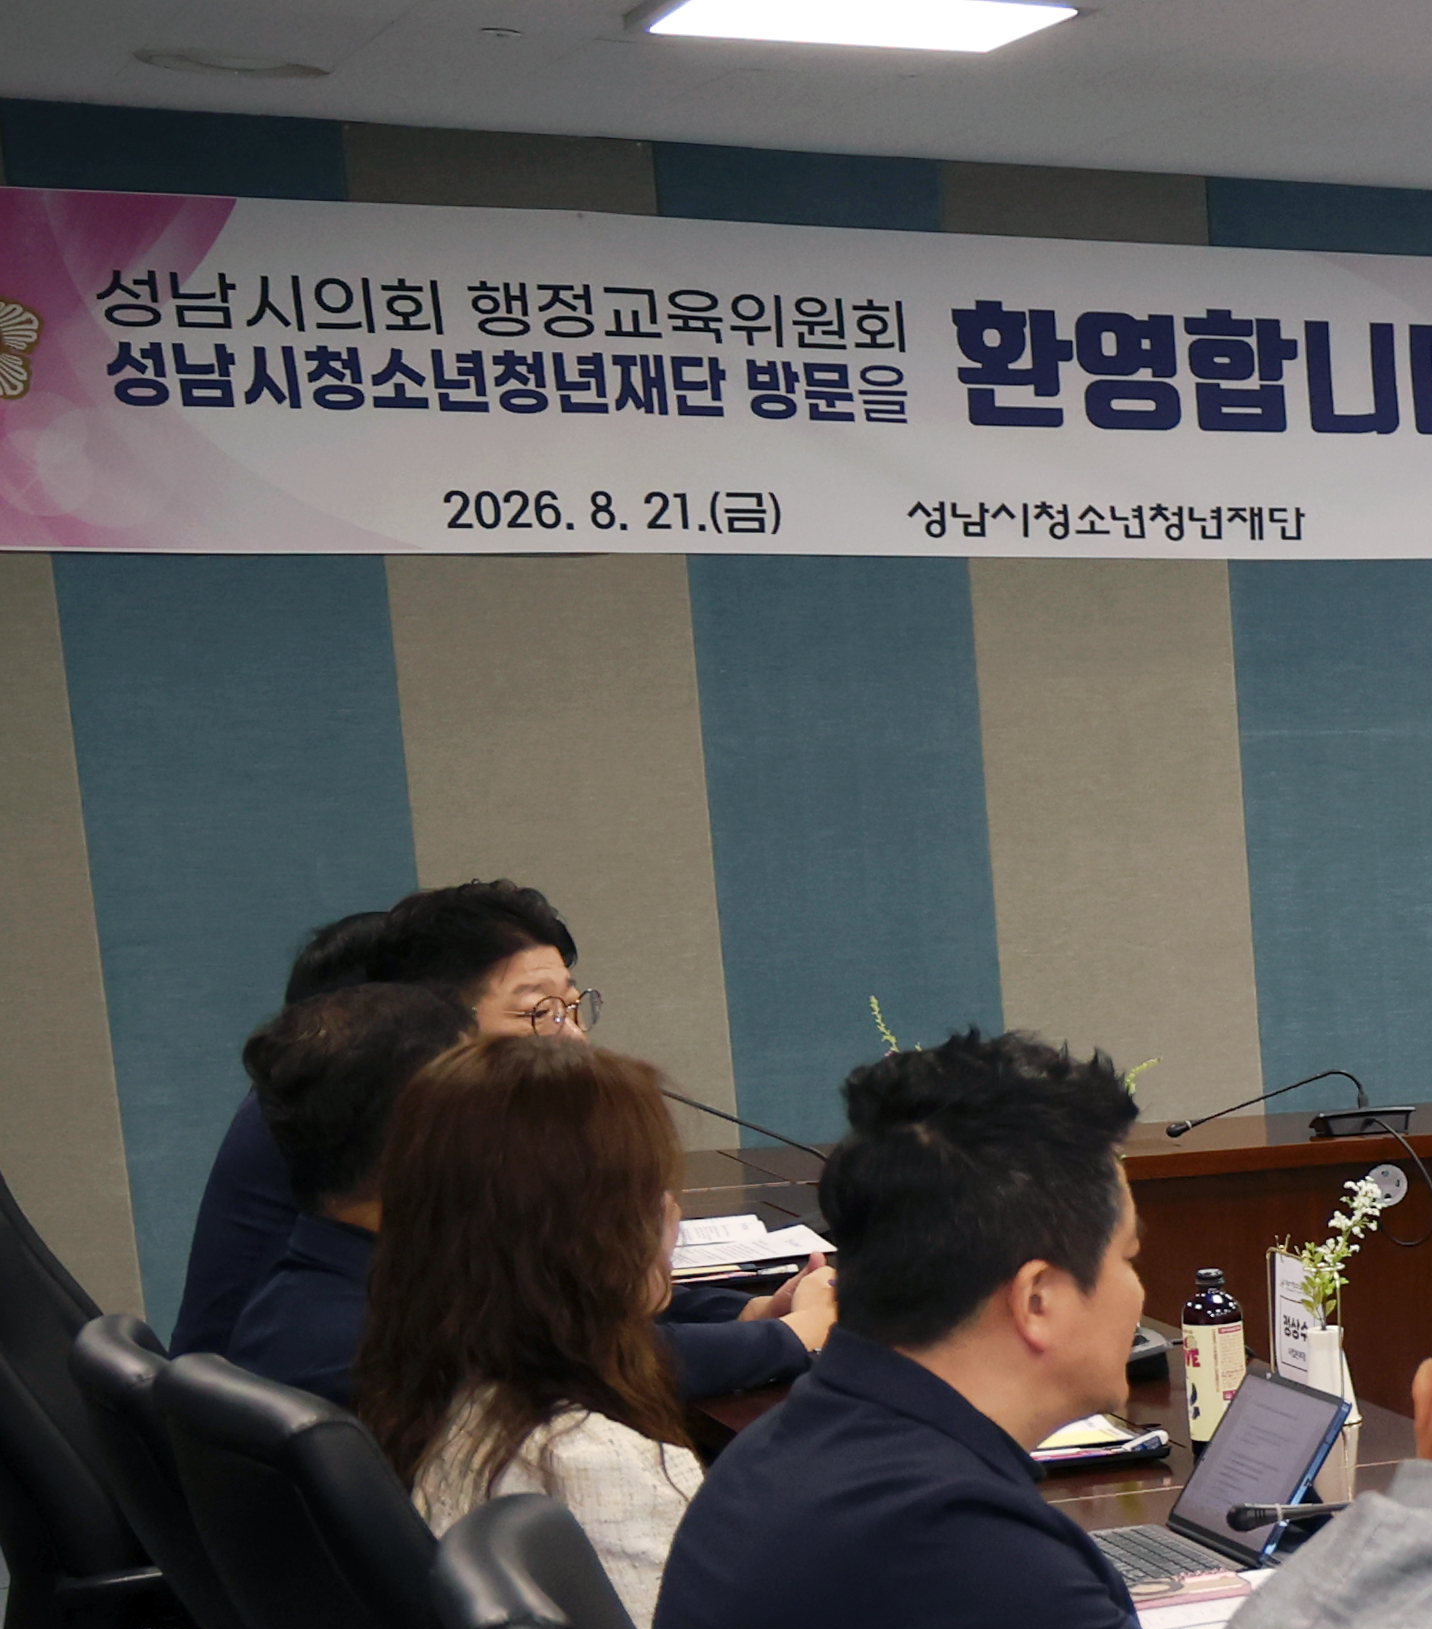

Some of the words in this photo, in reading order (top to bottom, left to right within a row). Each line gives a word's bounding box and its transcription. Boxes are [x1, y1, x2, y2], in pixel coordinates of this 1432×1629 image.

[95, 268, 445, 337] 성남시의회
[468, 280, 905, 354] 행정교육위원회
[105, 341, 727, 418] 성남시청소년청년재단
[747, 360, 908, 425] 방문을
[442, 489, 576, 532] 2026.
[589, 490, 629, 533] 8.
[643, 489, 783, 537] 21.(금)
[906, 500, 1306, 543] 성남시청소년청년재단
